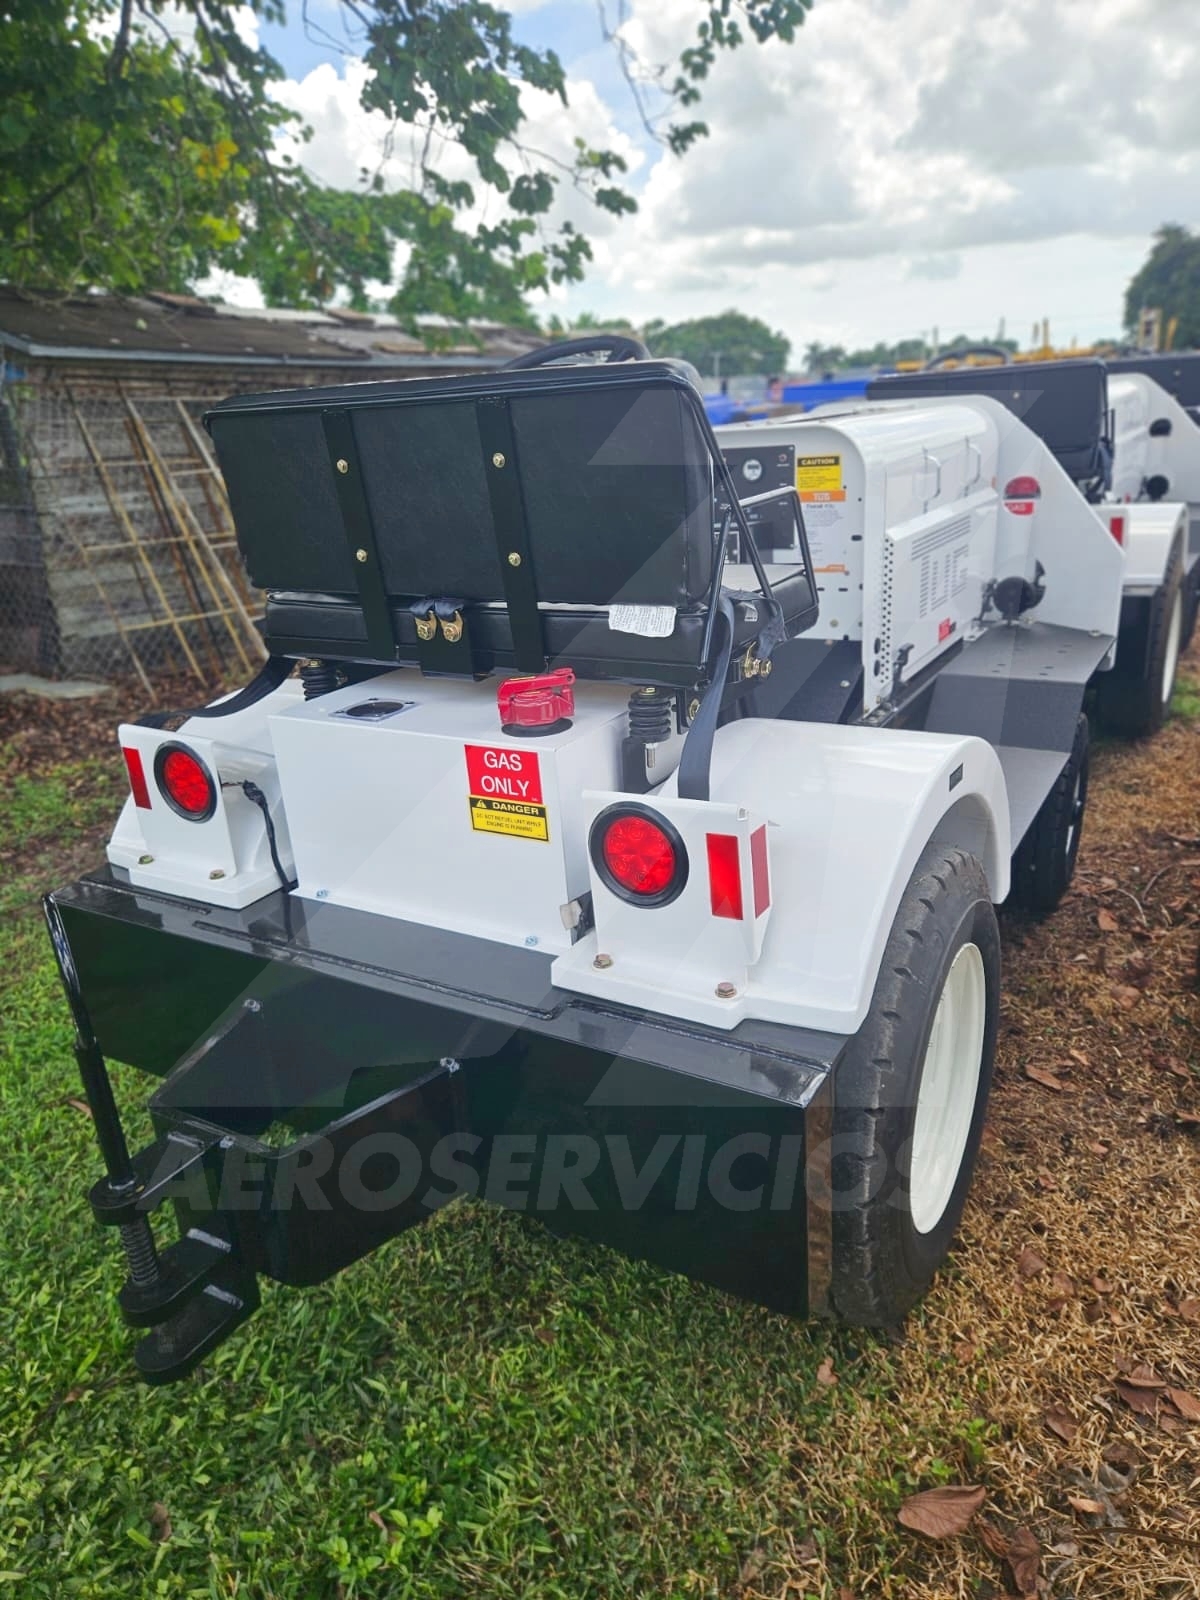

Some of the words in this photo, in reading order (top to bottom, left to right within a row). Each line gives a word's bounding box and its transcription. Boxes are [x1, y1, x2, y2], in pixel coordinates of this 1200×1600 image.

[801, 458, 835, 466] CAUTION
[483, 750, 523, 772] GAS
[480, 774, 530, 797] ONLY
[492, 801, 540, 816] DANGER
